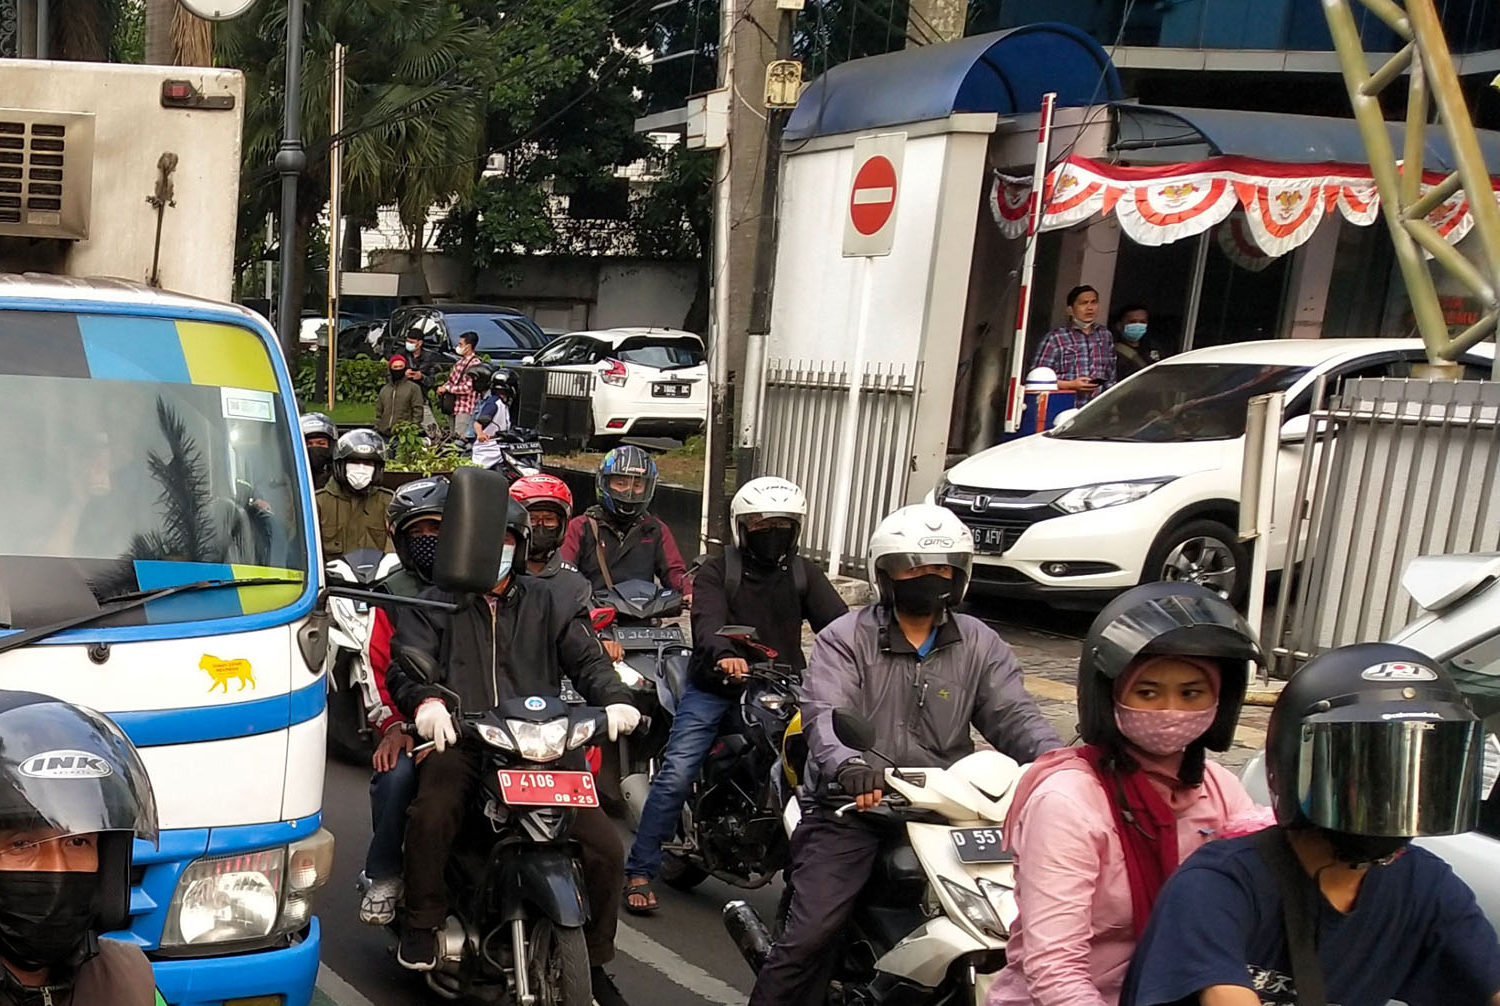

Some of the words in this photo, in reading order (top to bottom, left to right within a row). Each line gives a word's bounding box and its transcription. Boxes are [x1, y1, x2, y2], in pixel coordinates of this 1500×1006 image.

[985, 530, 1002, 544] AFV
[31, 757, 102, 772] INK
[501, 773, 512, 787] D
[520, 774, 555, 788] 4106
[582, 775, 592, 789] C
[952, 832, 966, 846] D
